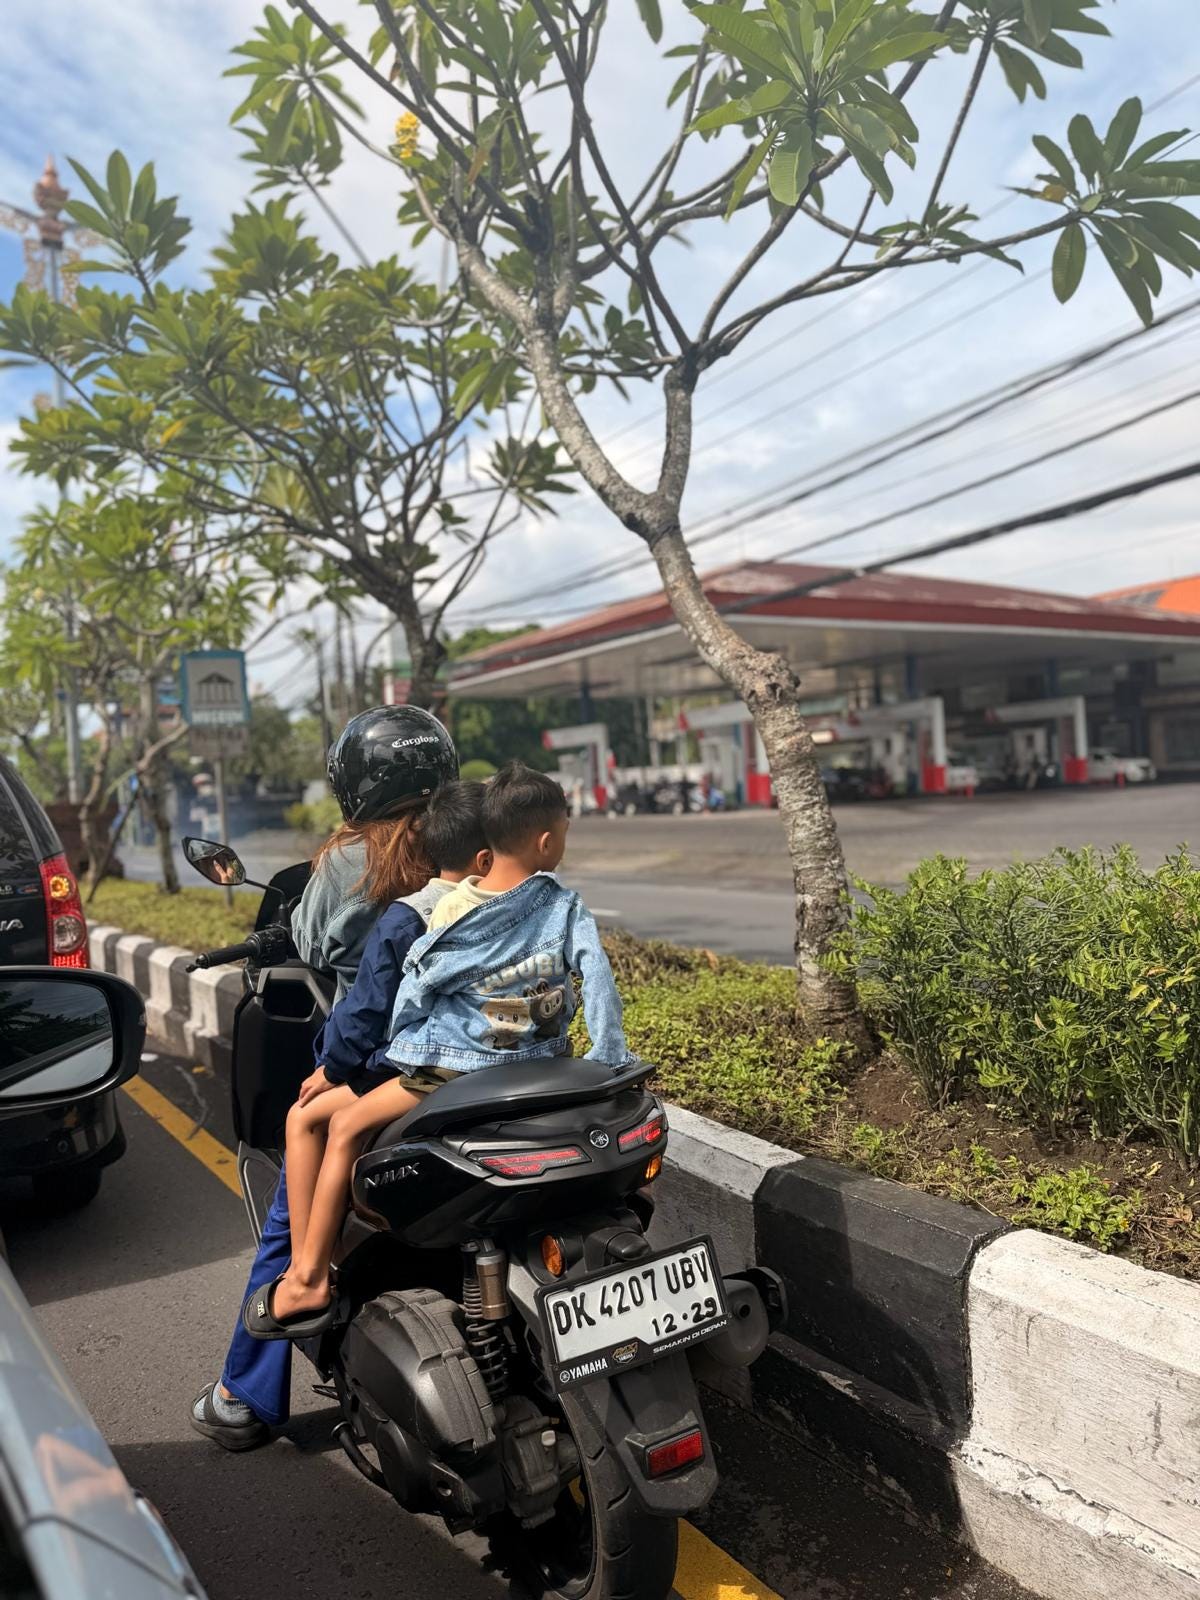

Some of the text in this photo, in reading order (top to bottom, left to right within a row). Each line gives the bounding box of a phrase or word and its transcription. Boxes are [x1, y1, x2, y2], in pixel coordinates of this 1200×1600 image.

[364, 1162, 420, 1189] NMAX
[553, 1250, 709, 1336] DK 4207 UBV
[653, 1335, 691, 1354] SEMAKIN
[692, 1331, 700, 1339] DI
[701, 1319, 727, 1335] DEPAN
[570, 1358, 608, 1380] YAMAHA
